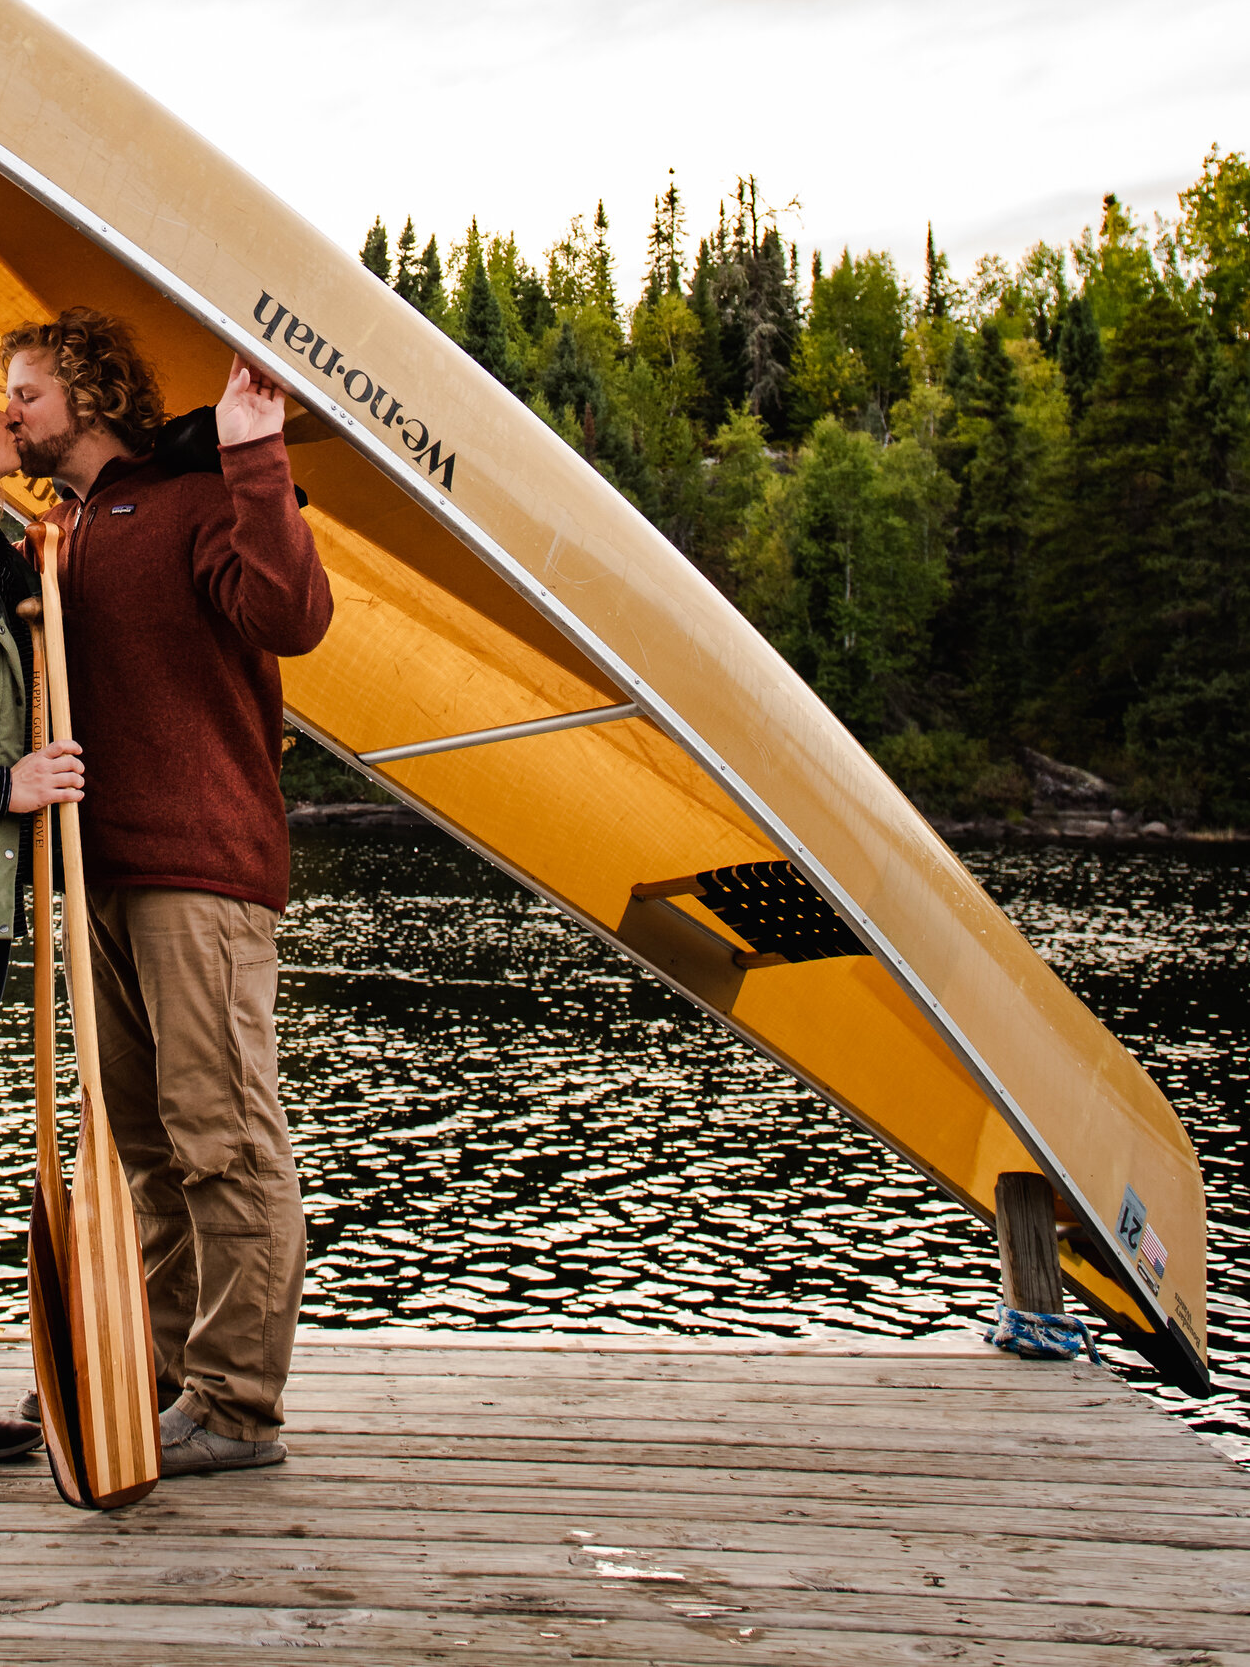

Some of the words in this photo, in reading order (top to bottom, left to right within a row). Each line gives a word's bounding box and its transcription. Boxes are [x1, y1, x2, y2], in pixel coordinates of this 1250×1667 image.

[33, 670, 41, 710] HAPPY
[35, 812, 44, 848] LOVE!
[1120, 1206, 1142, 1250] 21
[1174, 1292, 1192, 1324] Waters
[1174, 1305, 1201, 1349] Boundary
